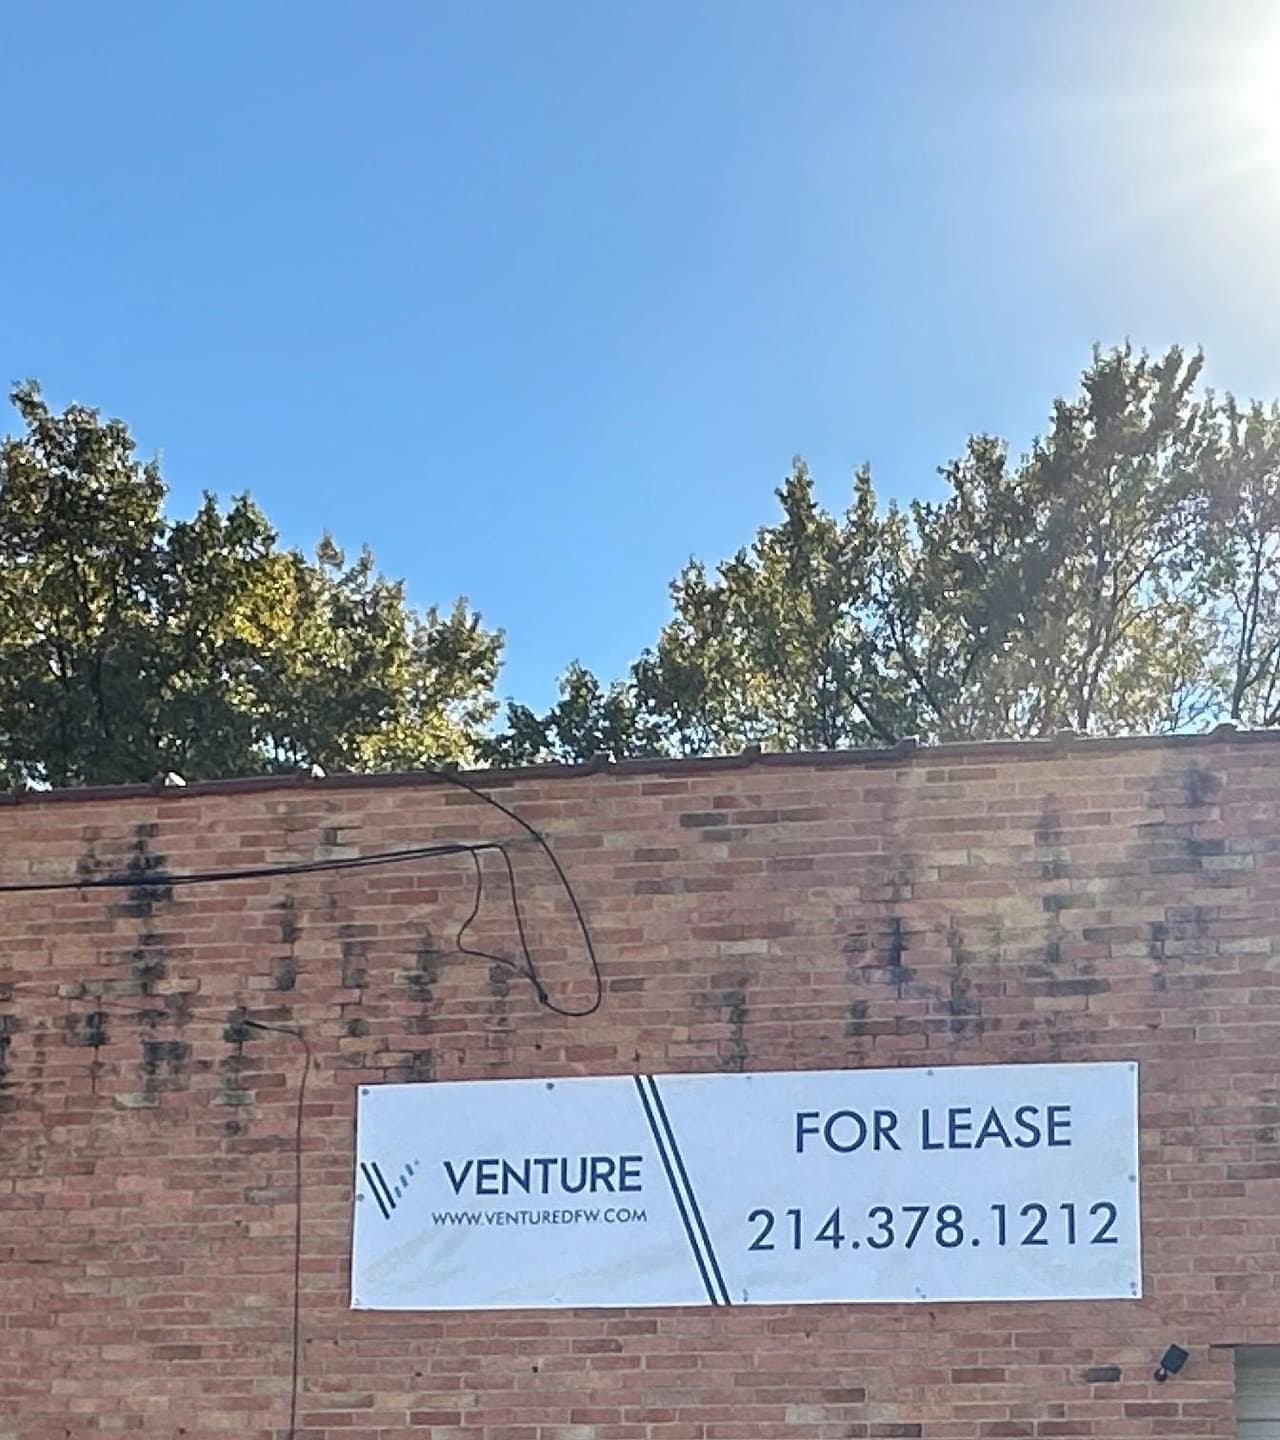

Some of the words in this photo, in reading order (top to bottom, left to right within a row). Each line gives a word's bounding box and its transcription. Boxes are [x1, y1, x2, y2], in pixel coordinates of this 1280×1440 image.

[795, 1109, 902, 1154] FOR
[922, 1105, 1073, 1151] LEASE
[442, 1155, 644, 1196] VENTURE
[431, 1207, 649, 1226] WWW.VENTUREDFW.COM
[747, 1201, 1119, 1251] 214.378.1212
